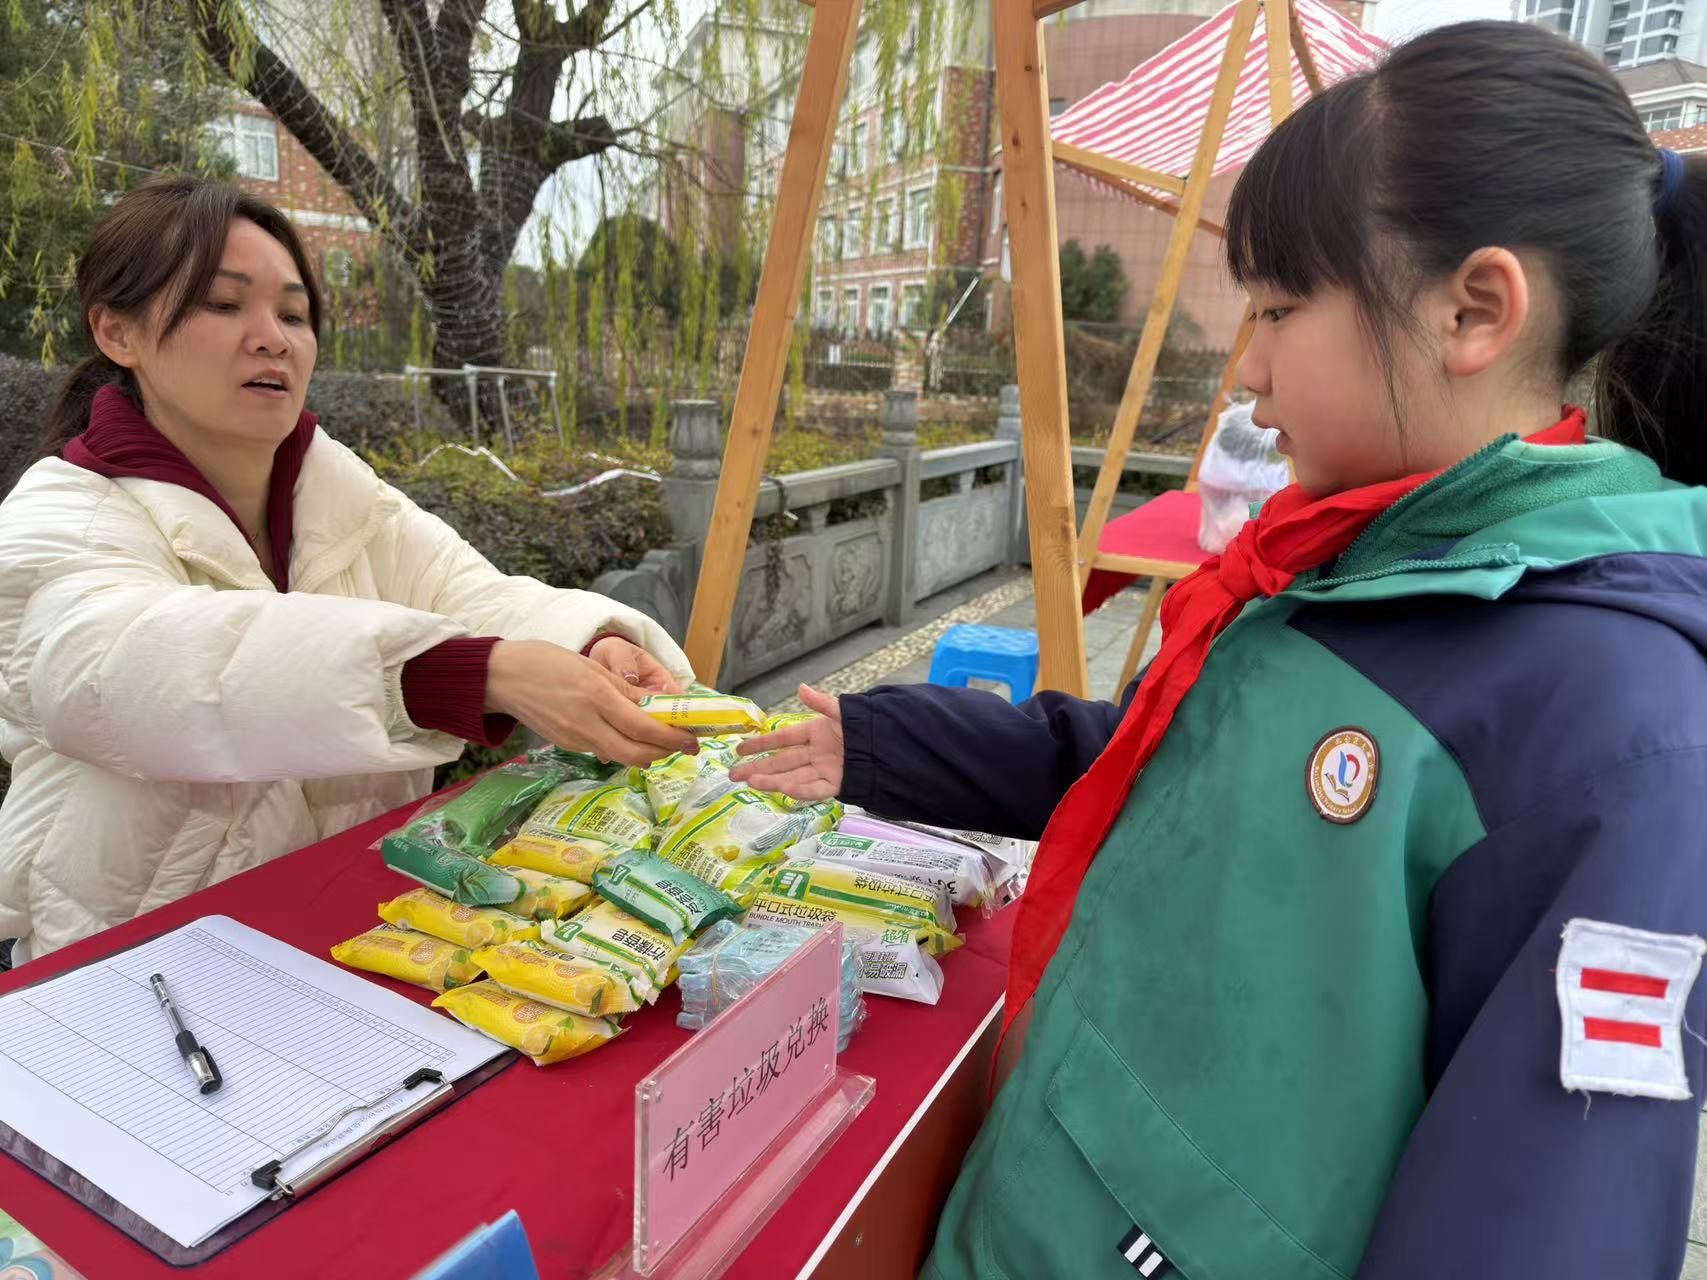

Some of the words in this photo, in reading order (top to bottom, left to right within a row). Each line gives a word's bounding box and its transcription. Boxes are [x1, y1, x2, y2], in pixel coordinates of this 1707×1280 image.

[655, 879, 702, 915] 芦荟香皂
[754, 898, 838, 922] 平口式垃圾袋
[749, 913, 775, 923] BUNDLE
[776, 917, 802, 927] MOUTH
[610, 927, 666, 962] 柠檬香皂
[880, 928, 911, 945] 超省
[661, 996, 829, 1182] 有害垃圾兑换
